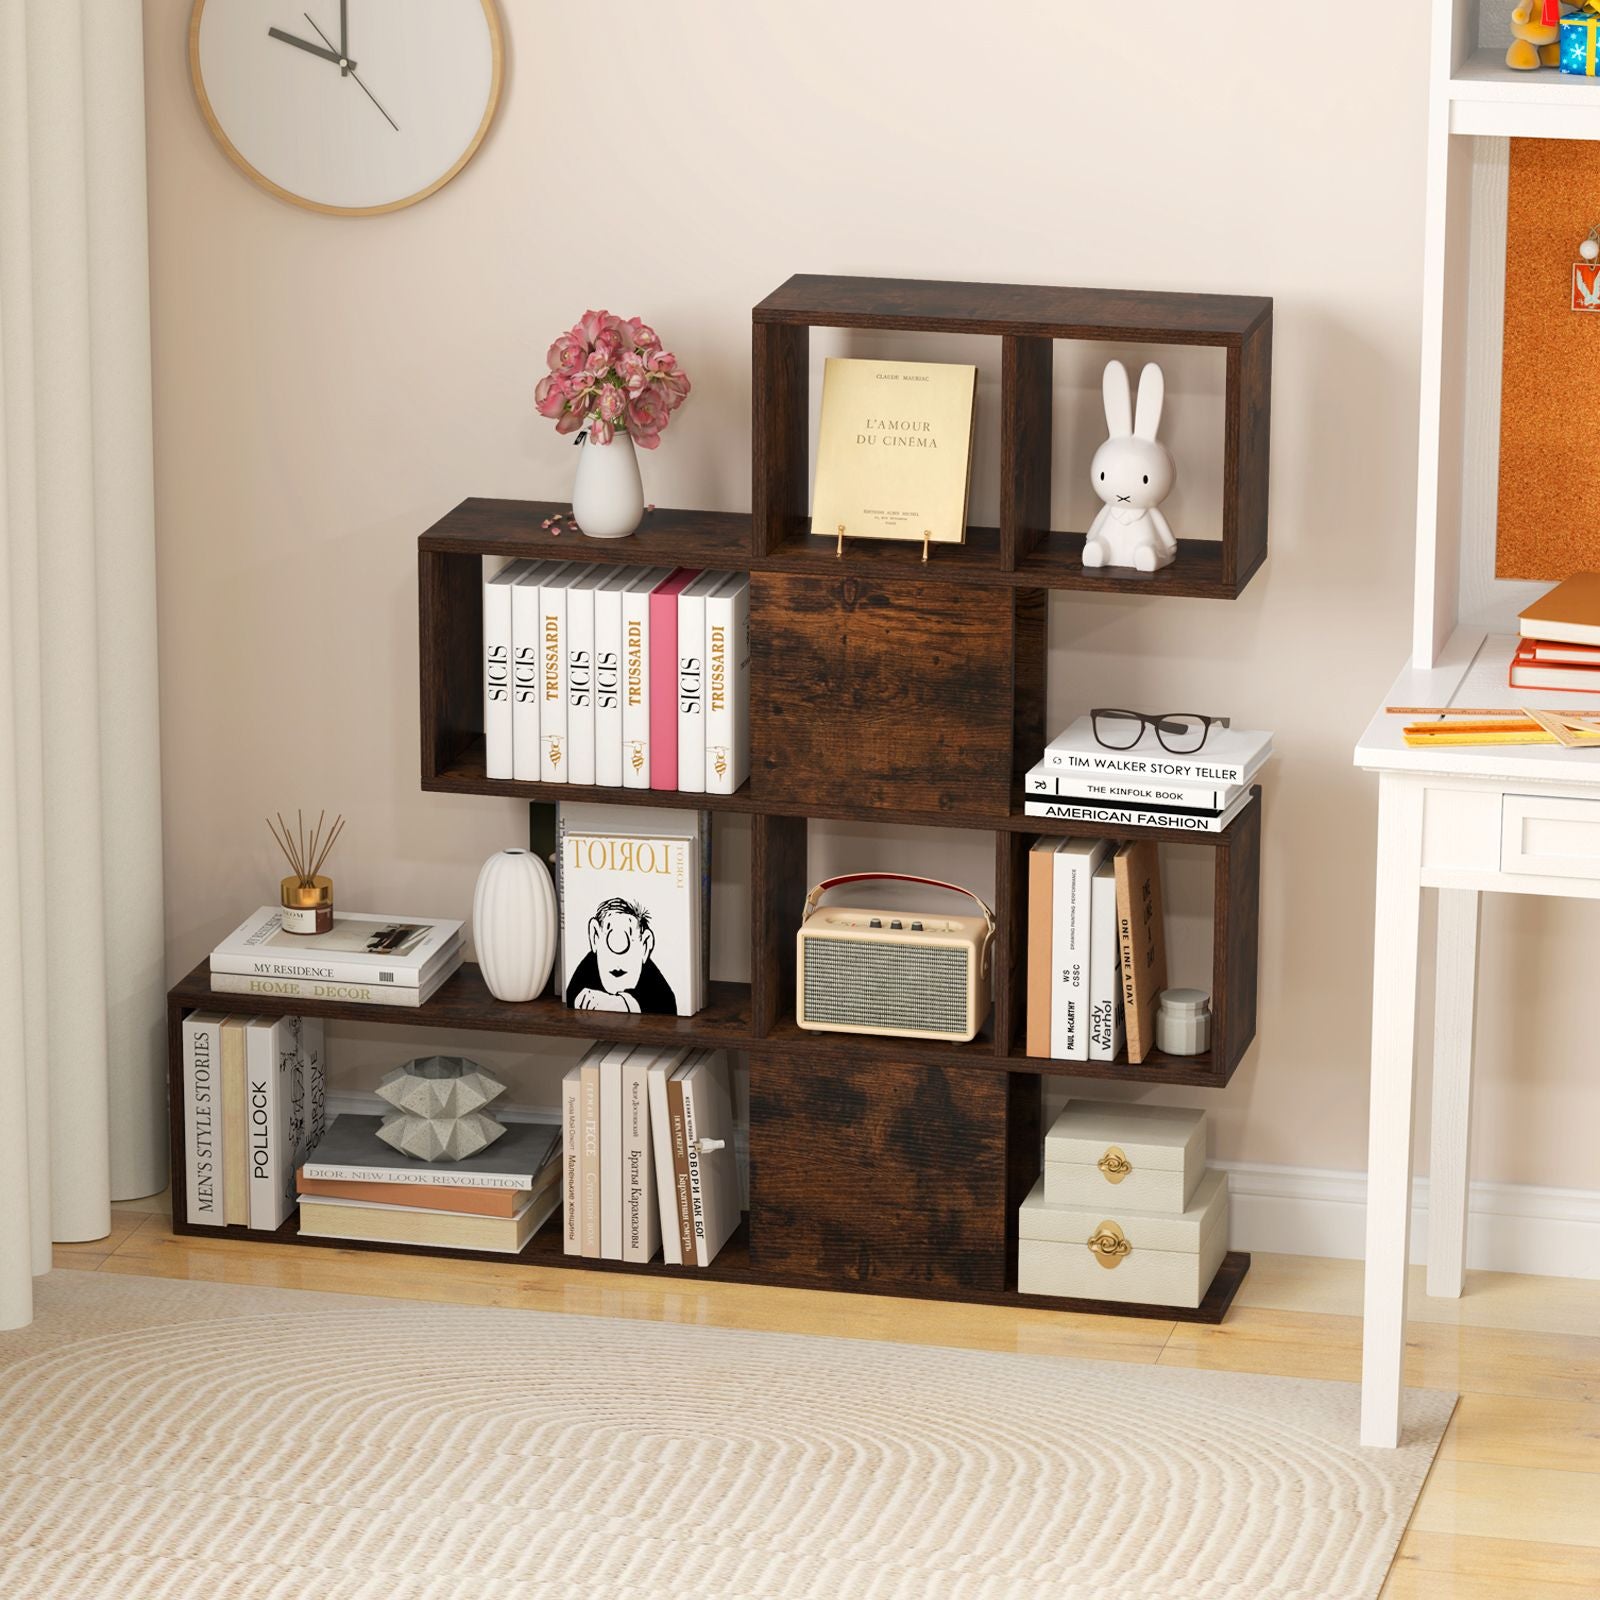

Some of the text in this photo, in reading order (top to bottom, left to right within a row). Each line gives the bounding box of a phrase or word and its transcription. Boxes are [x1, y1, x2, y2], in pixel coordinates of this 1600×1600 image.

[856, 435, 938, 448] DU CINÉMA
[866, 418, 931, 432] L'AMOUR
[488, 645, 507, 702] SICIS
[515, 647, 535, 703] SICIS
[545, 616, 558, 701] TRUSSARDI
[628, 621, 641, 706] TRUSSARDI
[711, 626, 725, 712] TRUSSARDI
[570, 651, 590, 707] SICIS
[597, 653, 618, 709] SICIS
[680, 658, 700, 714] SICIS
[1069, 756, 1237, 780] TIM WALKER STORY TELLER
[1087, 785, 1184, 800] THE KINFOLK BOOK
[1046, 806, 1209, 830] AMERICAN FASHION
[1121, 919, 1129, 940] ONE
[254, 963, 334, 978] MY RESIDENCE
[1123, 946, 1131, 969] LINE
[250, 980, 371, 1000] HOME DECOR
[1063, 969, 1070, 983] WS
[1073, 964, 1081, 987] CSSC
[1126, 985, 1134, 1006] DAY
[1092, 1005, 1104, 1044] Andy
[1102, 1000, 1112, 1050] Warhol
[1067, 1033, 1075, 1050] PAUL
[194, 1031, 214, 1213] MEN'S STYLE STORIES
[251, 1081, 269, 1179] POLLOCK
[585, 1119, 595, 1157] ГЕССЕ
[352, 1171, 385, 1180] NEW
[388, 1173, 428, 1183] LOOK
[432, 1175, 525, 1188] REVOLUTION
[628, 1150, 642, 1185] Братья
[688, 1144, 700, 1193] ГОВОРИ
[678, 1173, 690, 1219] Бархатная
[693, 1198, 702, 1216] КАК
[628, 1187, 642, 1249] Карамазовы
[695, 1220, 704, 1239] БОГ
[681, 1220, 692, 1252] смерть
